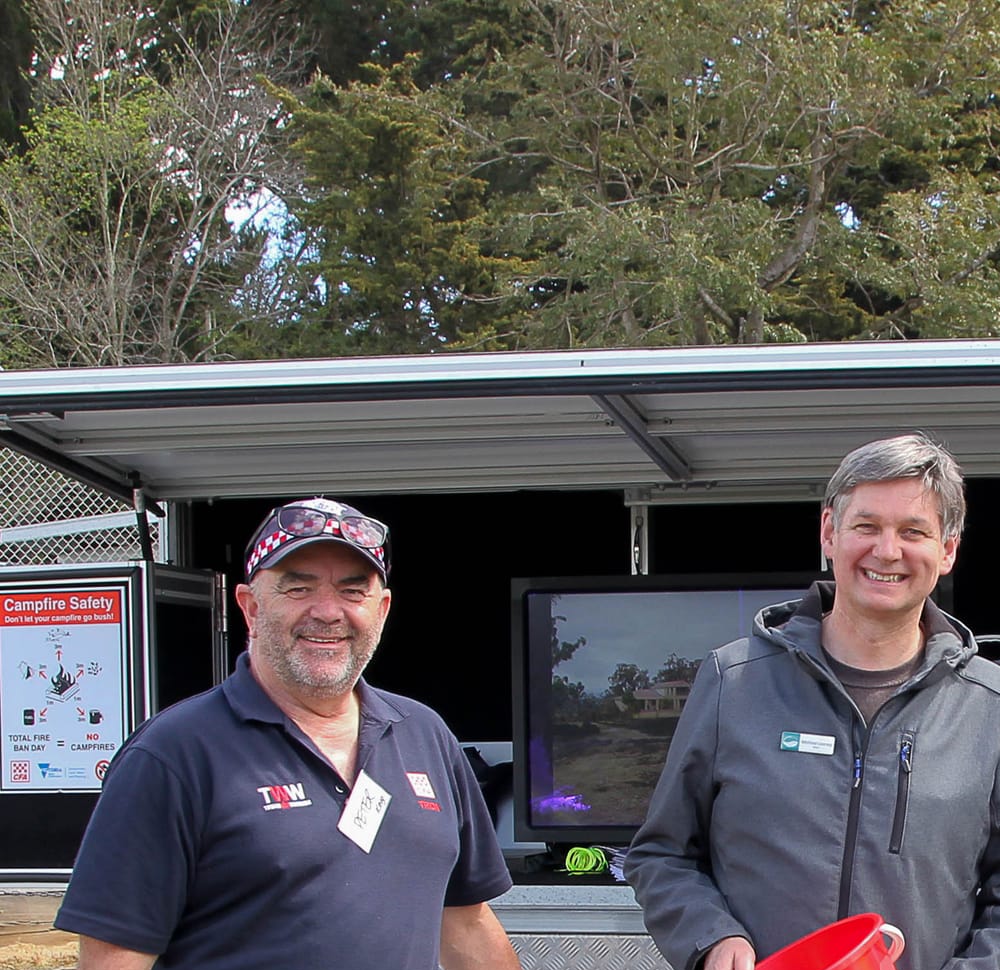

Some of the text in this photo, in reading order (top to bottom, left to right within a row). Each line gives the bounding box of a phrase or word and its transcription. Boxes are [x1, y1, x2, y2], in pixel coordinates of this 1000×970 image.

[4, 596, 113, 613] Campfire Safety
[4, 615, 24, 623] Don't
[34, 615, 50, 624] your
[51, 614, 81, 623] campfire
[83, 614, 93, 622] go
[8, 734, 32, 742] TOTAL
[86, 733, 99, 741] NO
[13, 744, 30, 752] BAN
[71, 743, 115, 751] CAMPFIRES
